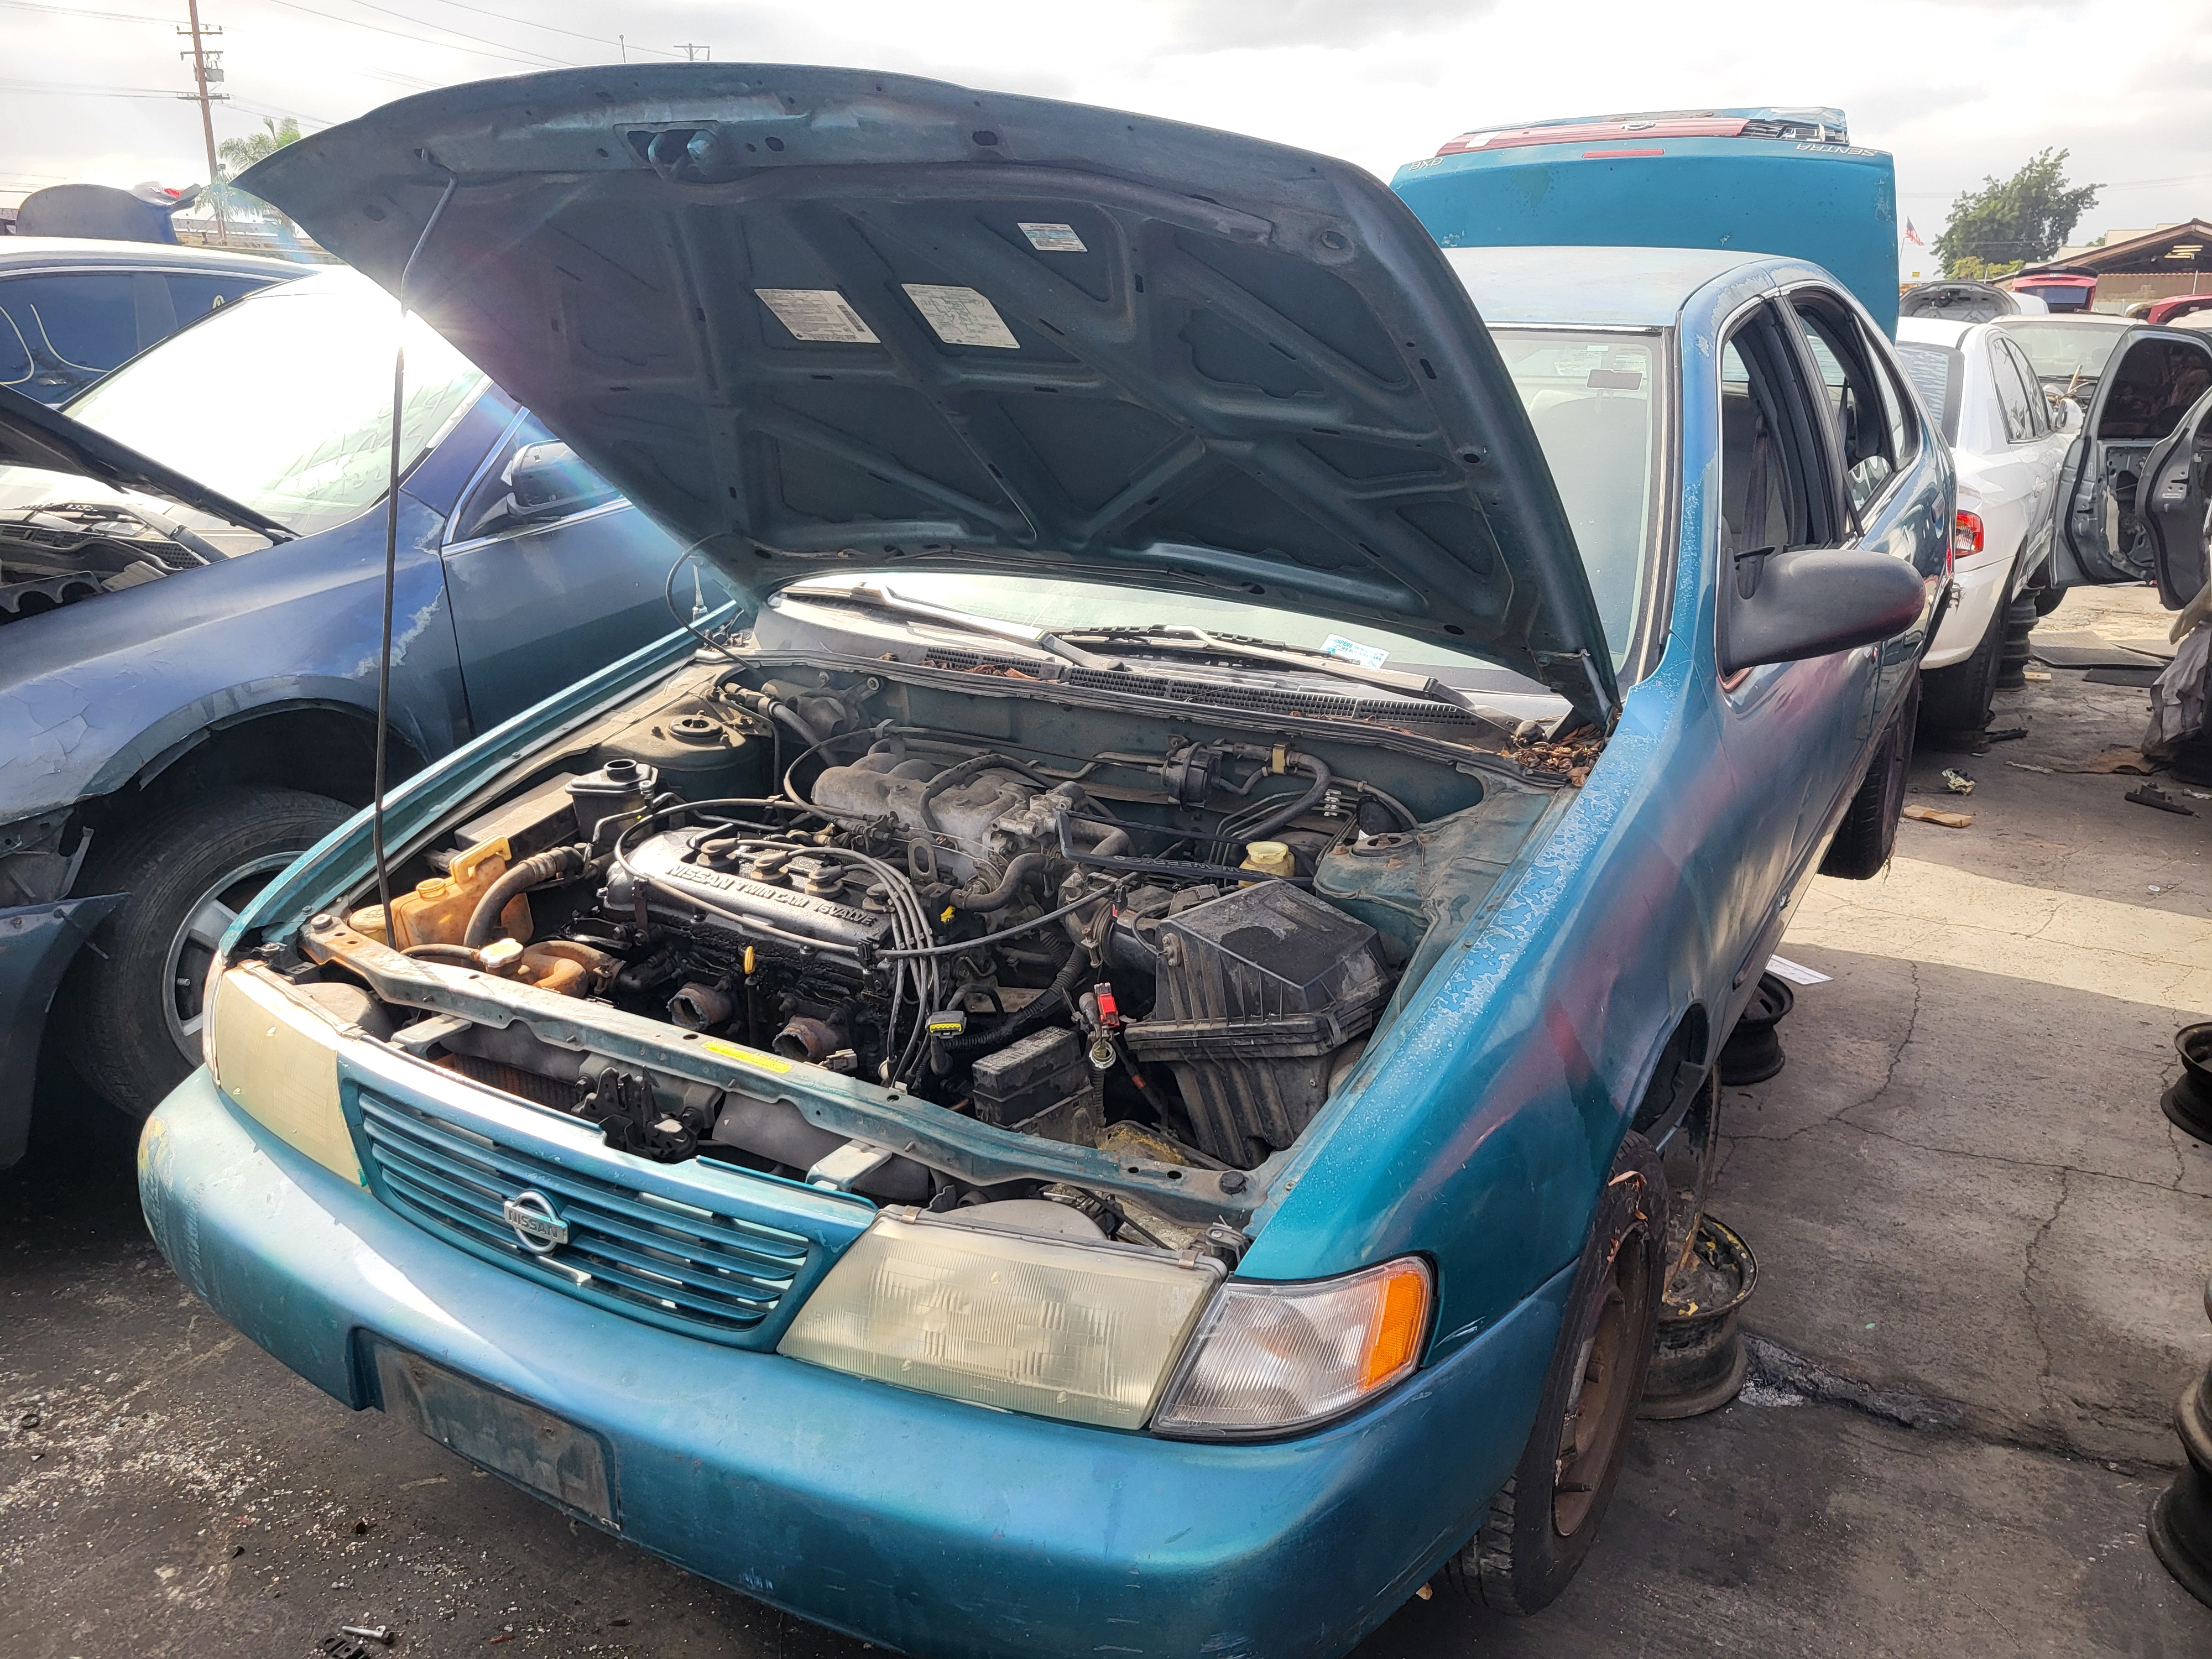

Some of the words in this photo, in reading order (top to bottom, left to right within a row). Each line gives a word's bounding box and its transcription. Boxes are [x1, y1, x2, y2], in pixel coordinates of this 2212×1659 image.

[1796, 143, 1876, 156] SENTRA
[1408, 158, 1444, 171] GXE
[665, 866, 735, 890] NISSAN
[736, 880, 777, 900] TWIN
[774, 892, 810, 907] CAM
[509, 1209, 559, 1239] NISSAN
